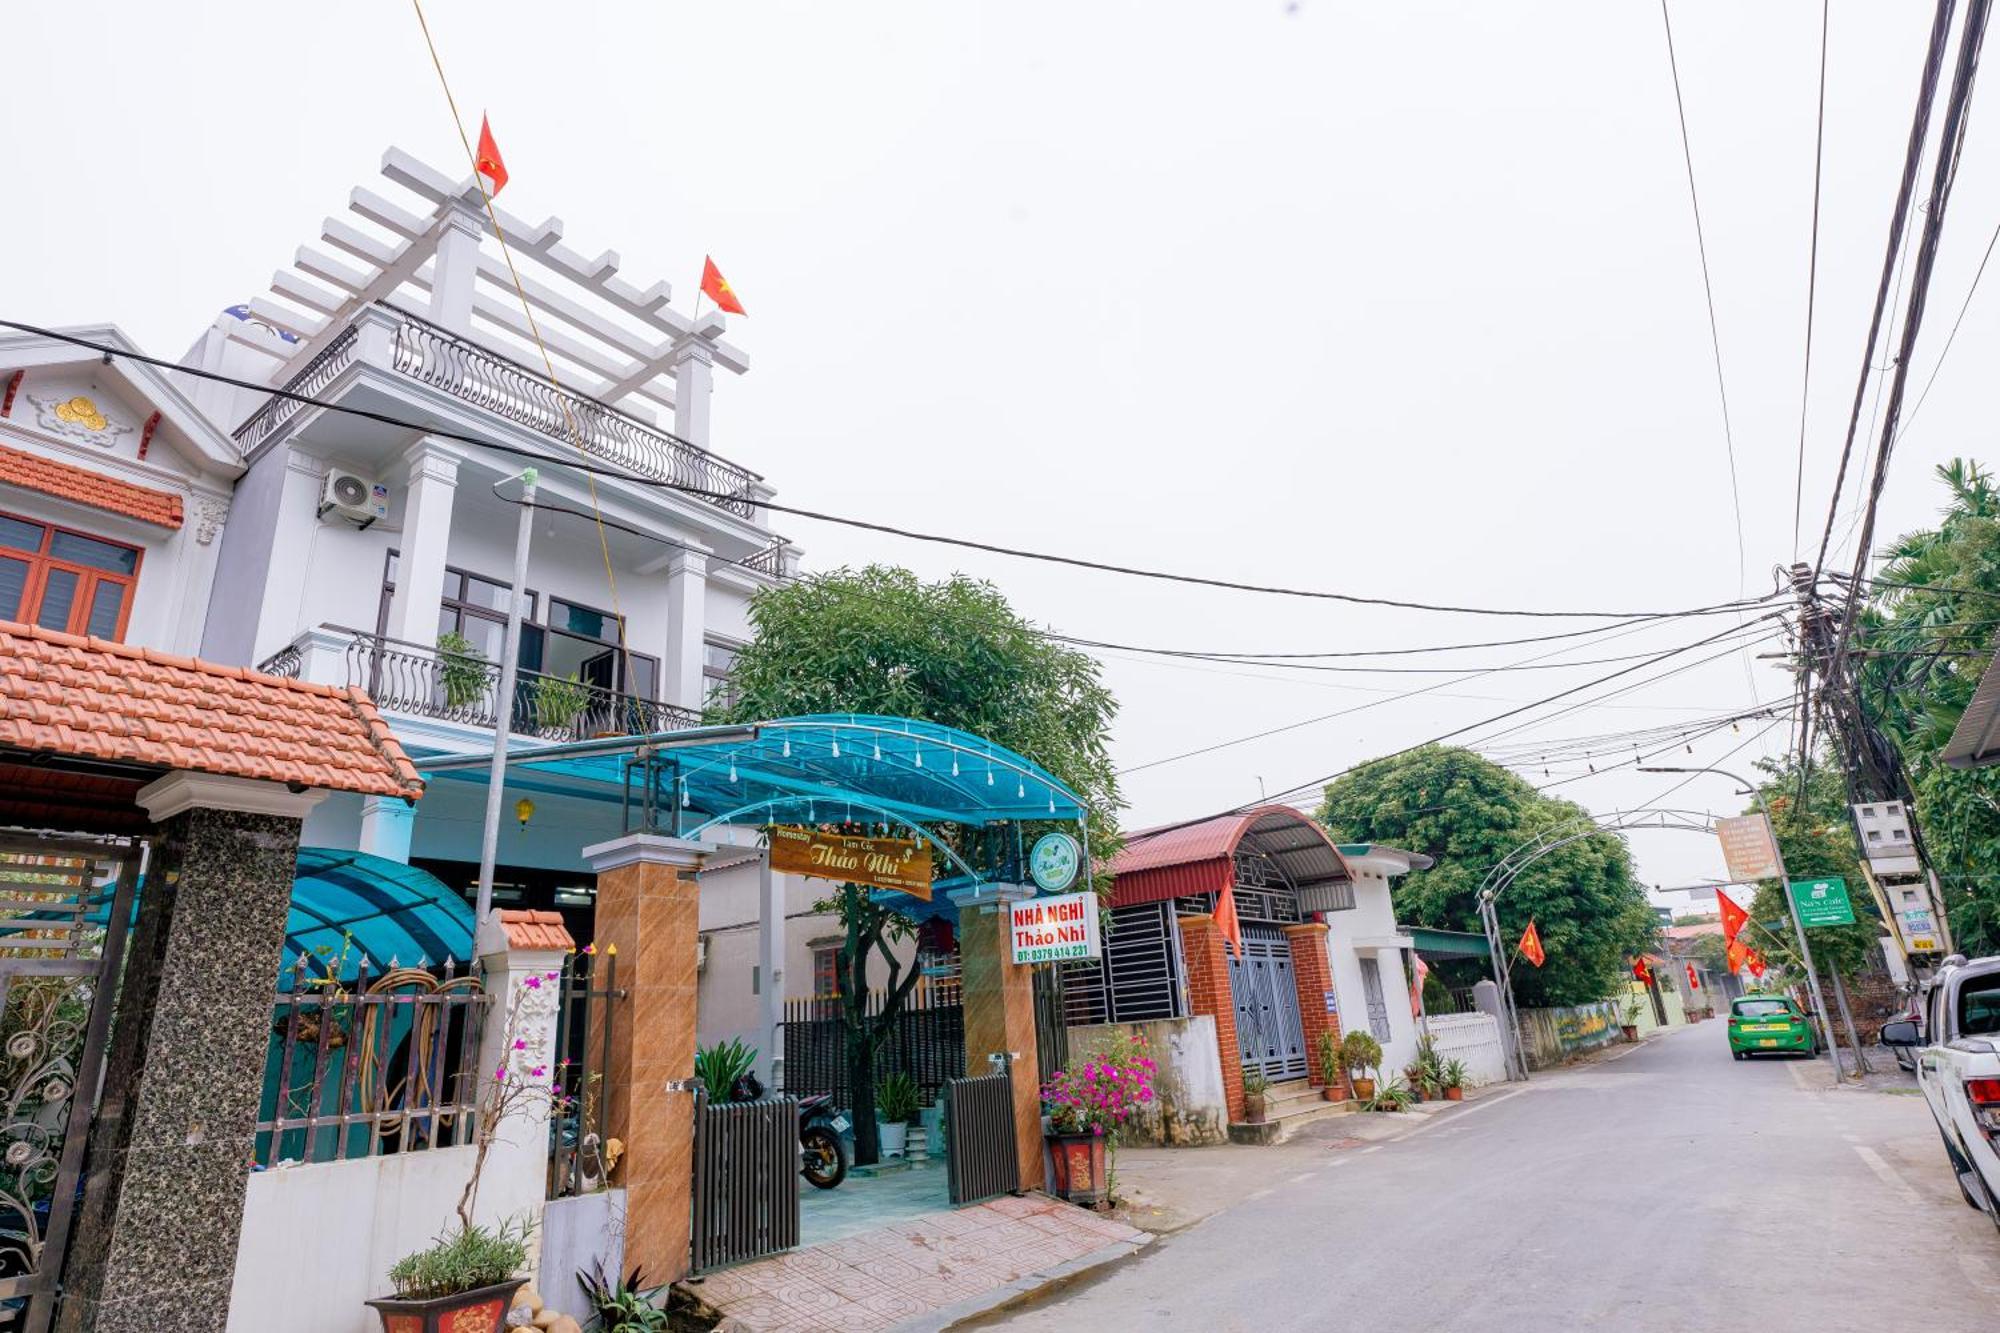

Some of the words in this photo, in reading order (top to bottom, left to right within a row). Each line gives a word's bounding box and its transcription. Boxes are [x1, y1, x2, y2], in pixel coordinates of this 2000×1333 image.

[810, 844, 857, 870] Thảo
[863, 852, 900, 875] Nhi
[1014, 903, 1044, 927] NHÀ
[1047, 896, 1084, 923] NGHỈ
[1015, 929, 1054, 947] Thảo
[1057, 924, 1086, 942] Nhi
